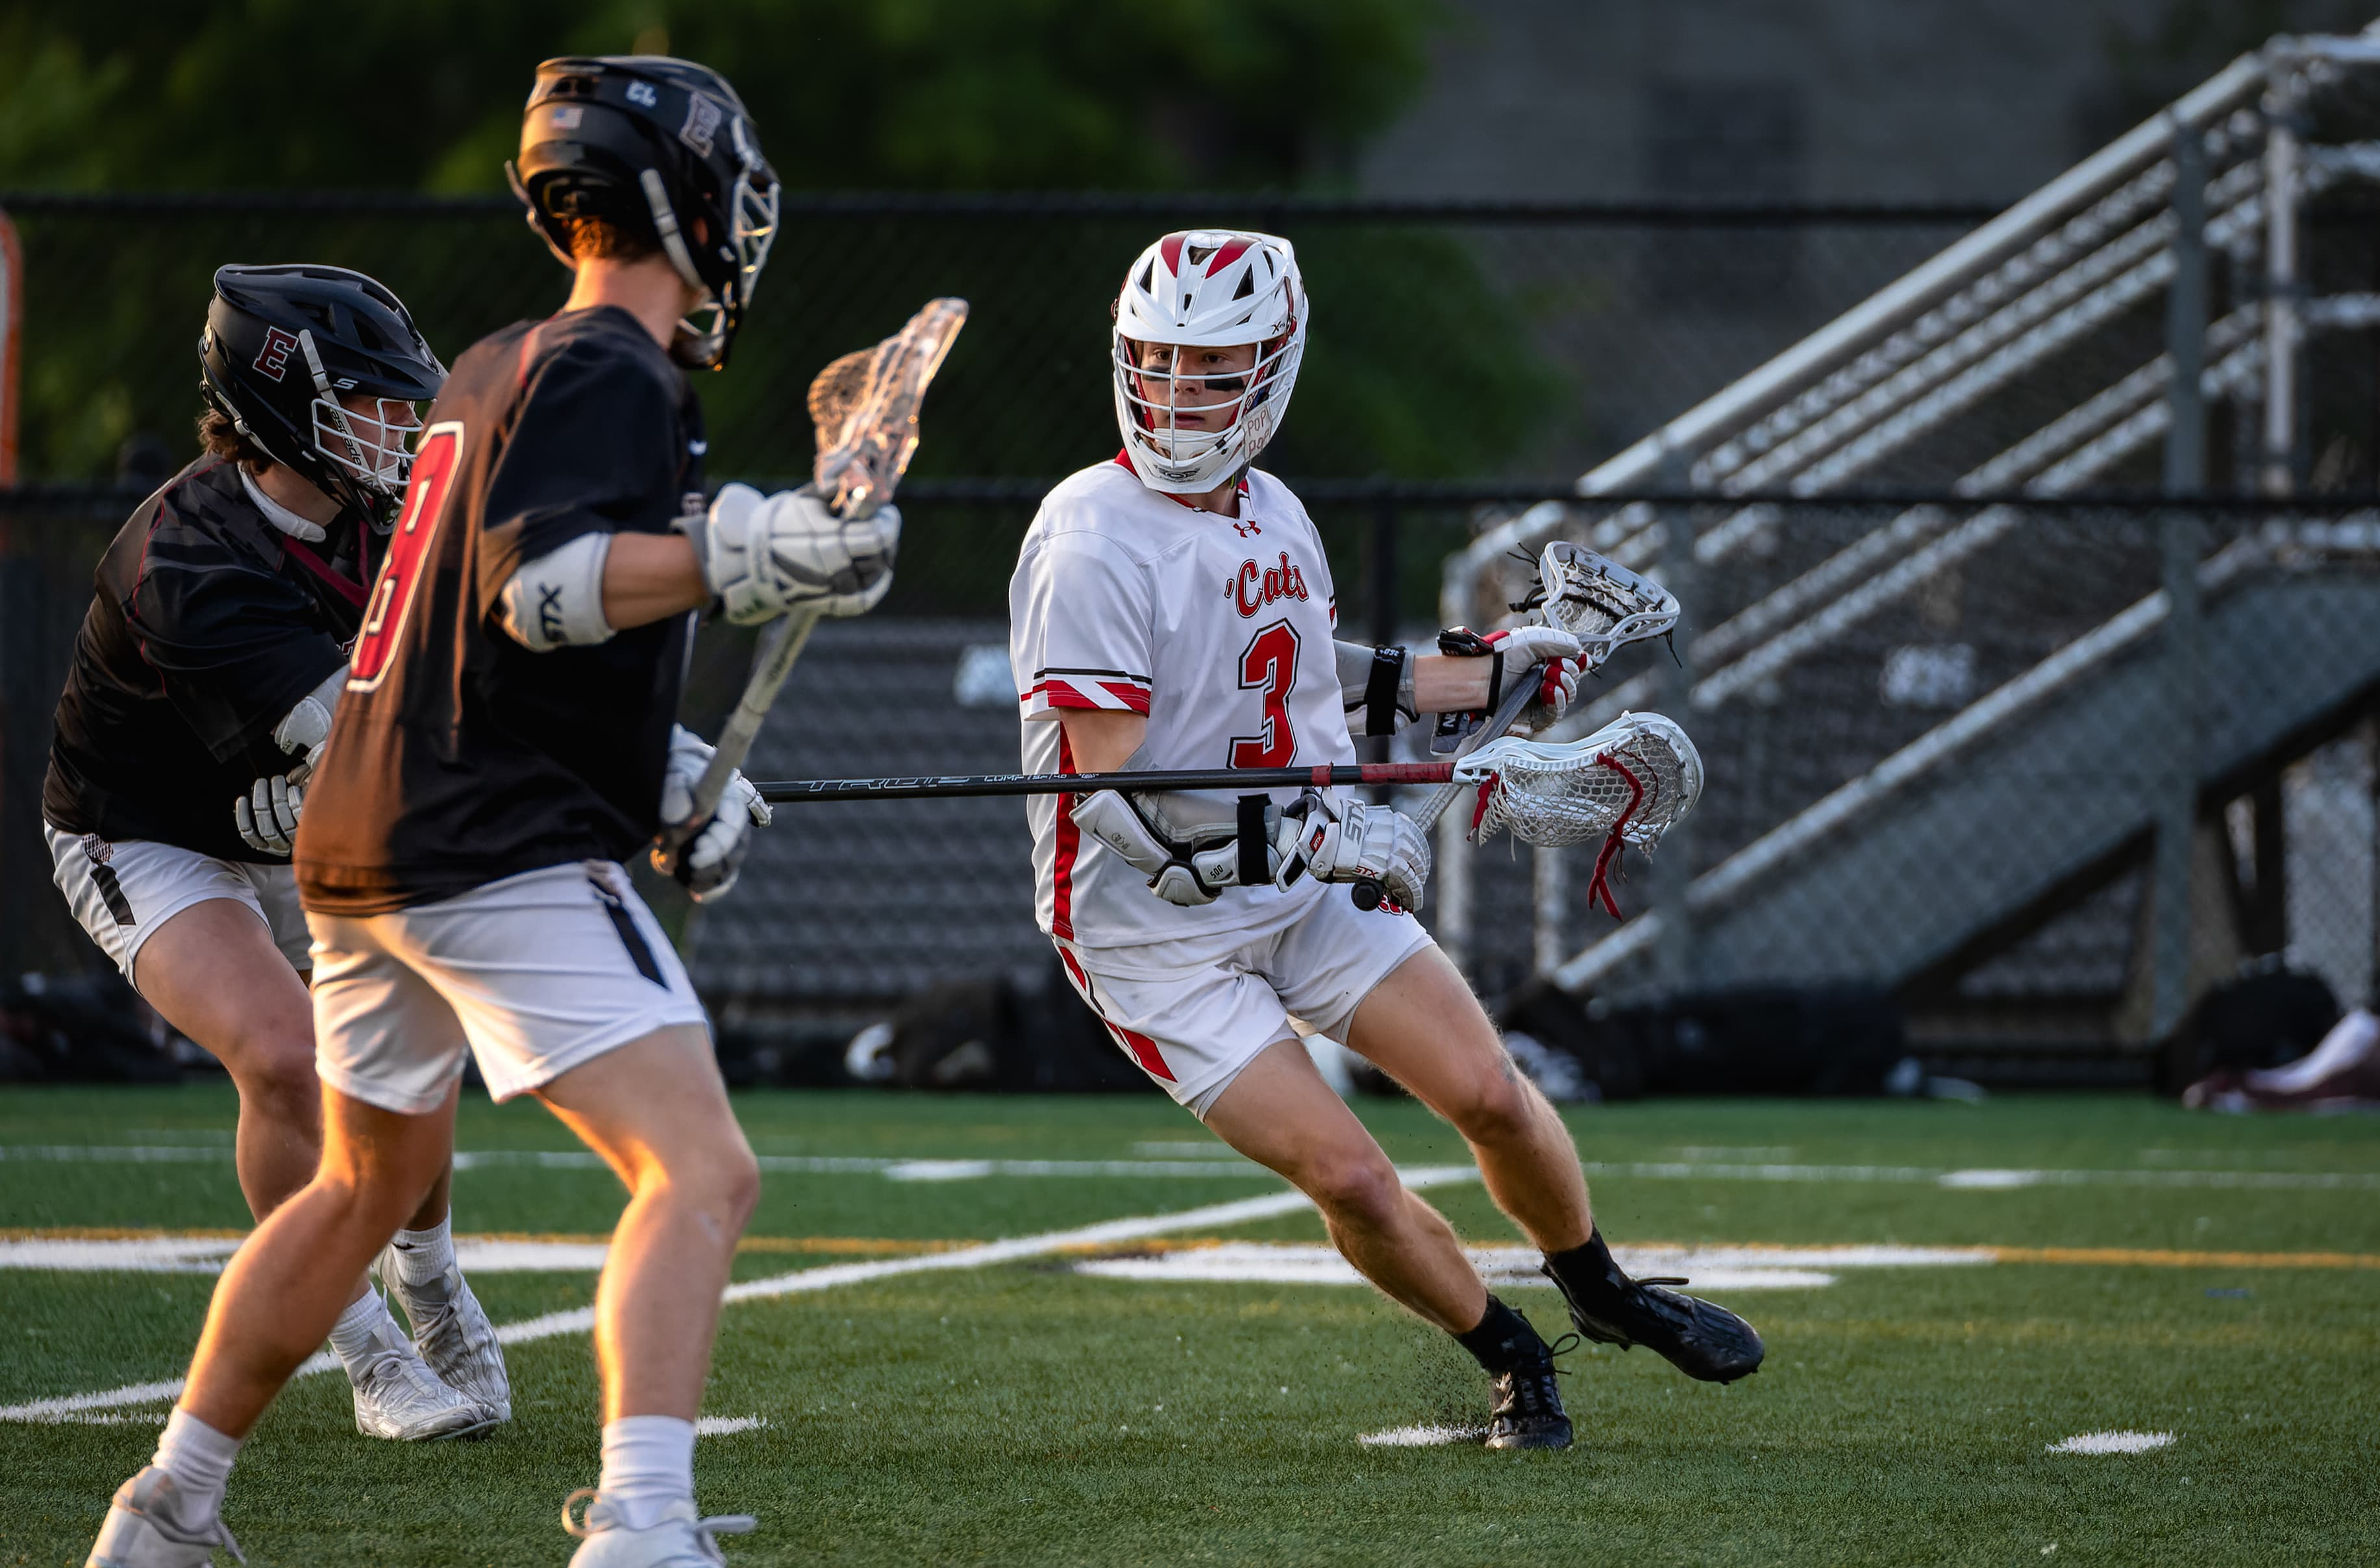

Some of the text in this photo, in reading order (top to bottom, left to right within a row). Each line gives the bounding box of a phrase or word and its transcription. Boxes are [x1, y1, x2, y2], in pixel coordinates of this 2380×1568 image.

[253, 325, 299, 384] E
[1247, 408, 1267, 437] POP
[1226, 617, 1301, 768] 3
[1345, 799, 1365, 845] STX
[1210, 864, 1224, 879] 500
[1351, 865, 1381, 878] STX
